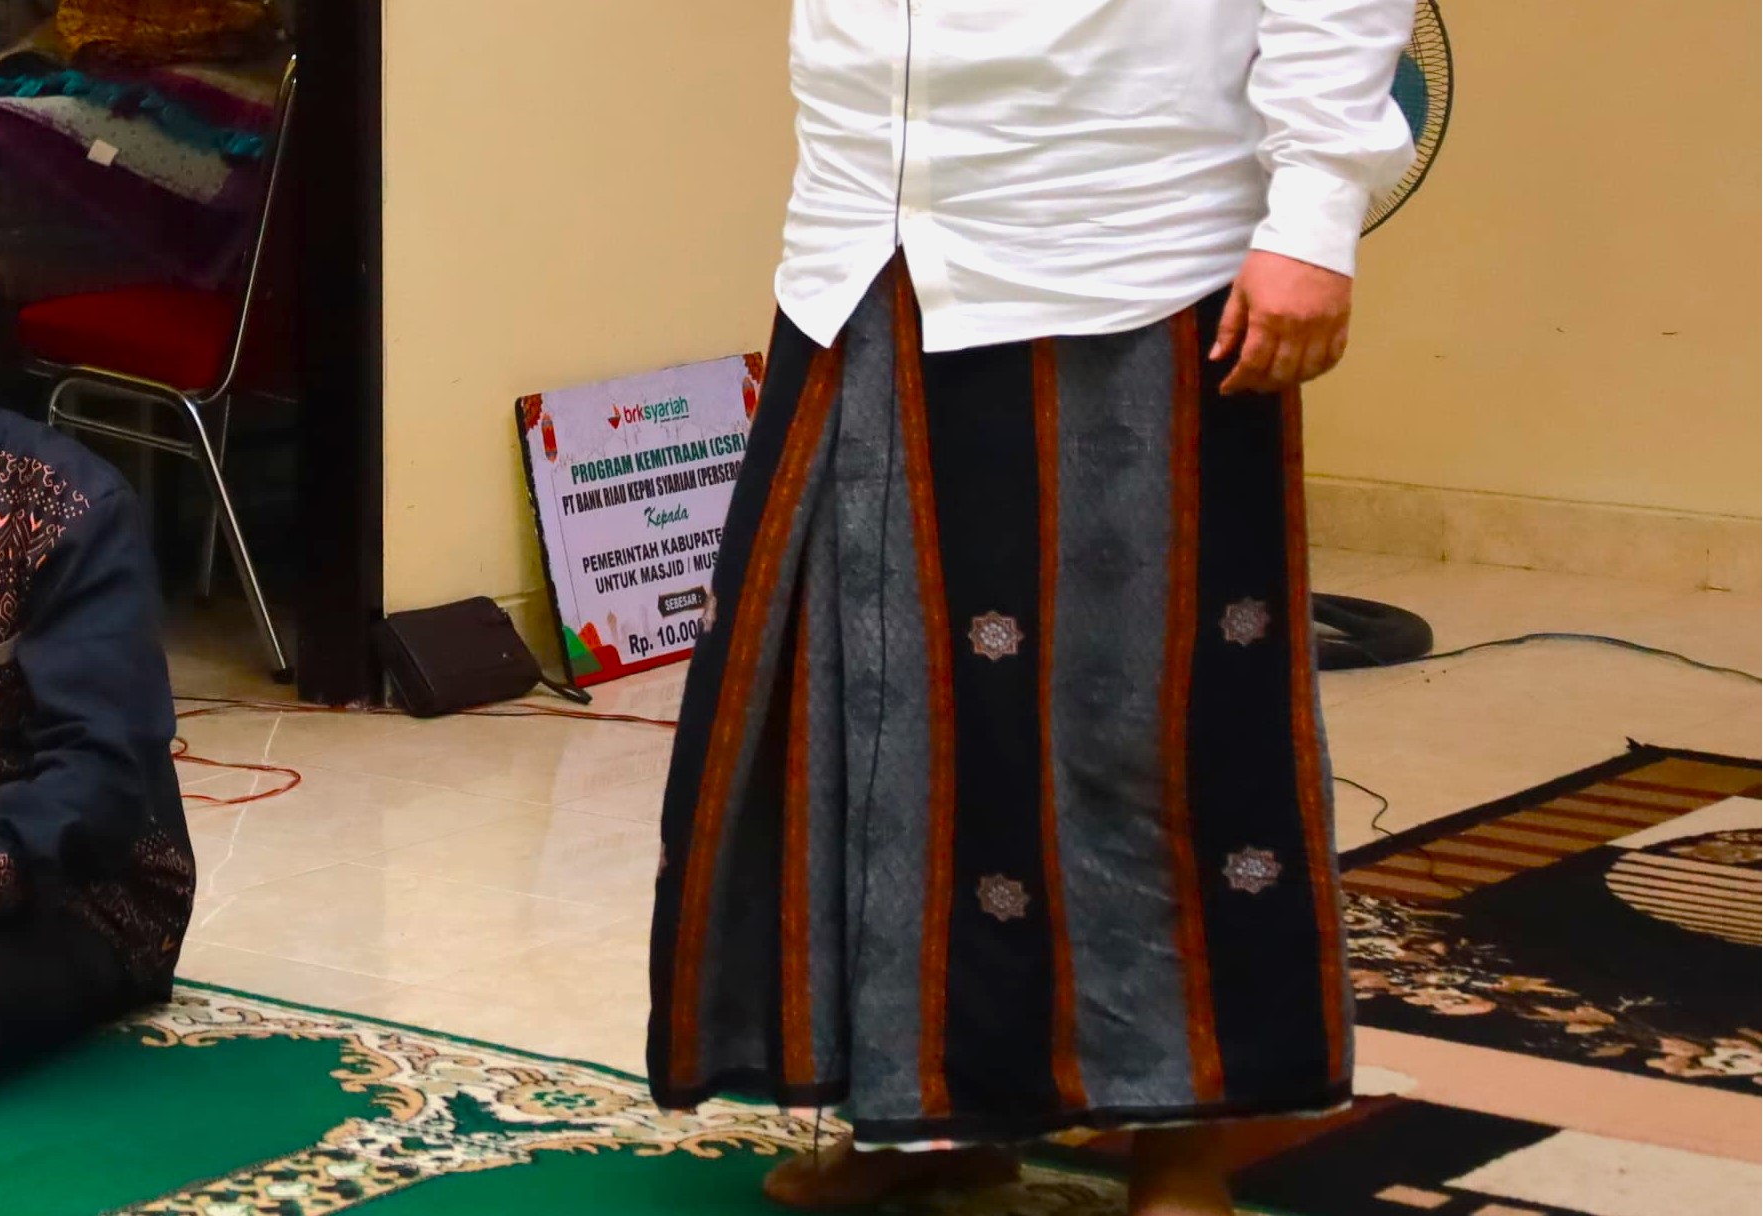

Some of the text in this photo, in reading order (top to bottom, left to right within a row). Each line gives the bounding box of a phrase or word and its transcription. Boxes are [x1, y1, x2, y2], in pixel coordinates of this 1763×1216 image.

[623, 395, 689, 424] brksyariah
[571, 454, 634, 485] PROGRAM
[635, 441, 708, 472] KEMITRAAN
[562, 494, 575, 516] PT
[575, 487, 603, 513] BANK
[603, 483, 626, 507] RIAU
[627, 477, 656, 502] KEPRI
[656, 469, 697, 496] SYARIAH
[644, 503, 689, 529] Kepada
[582, 542, 659, 574] PEMERINTAH
[595, 568, 637, 594] UNTUK
[640, 560, 684, 584] MASJID
[629, 634, 653, 657] Rp.
